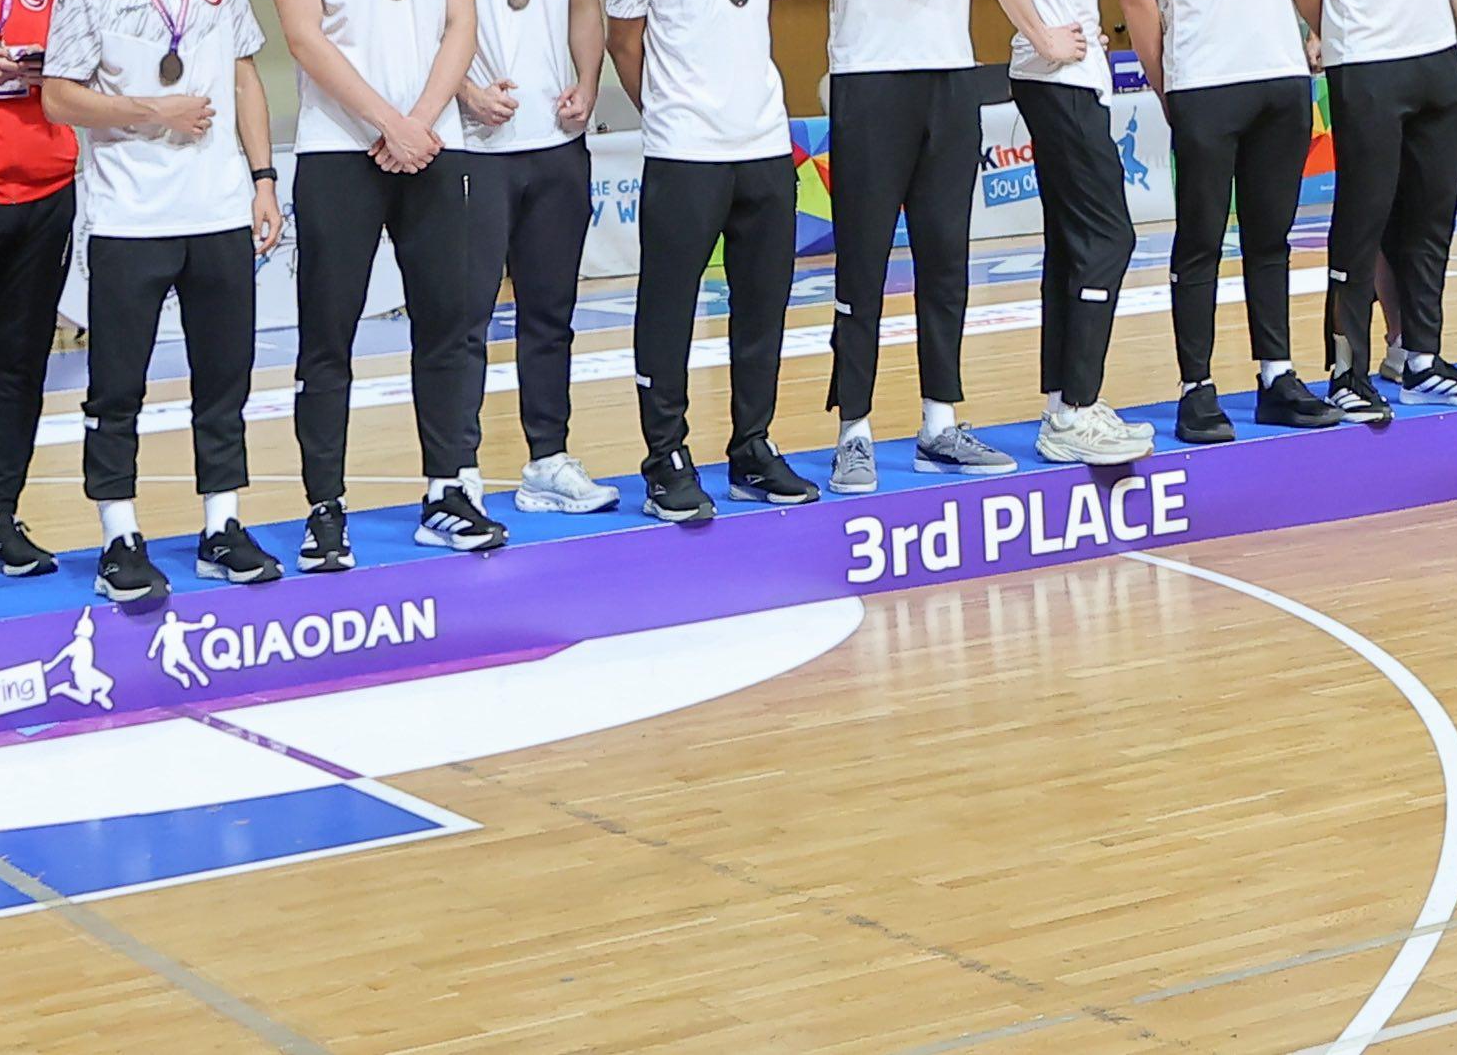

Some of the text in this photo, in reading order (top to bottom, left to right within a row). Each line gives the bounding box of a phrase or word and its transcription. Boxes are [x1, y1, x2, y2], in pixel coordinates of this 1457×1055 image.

[989, 178, 1020, 200] Joy
[843, 468, 1190, 585] 3rd PLACE
[200, 596, 438, 672] QIAODAN
